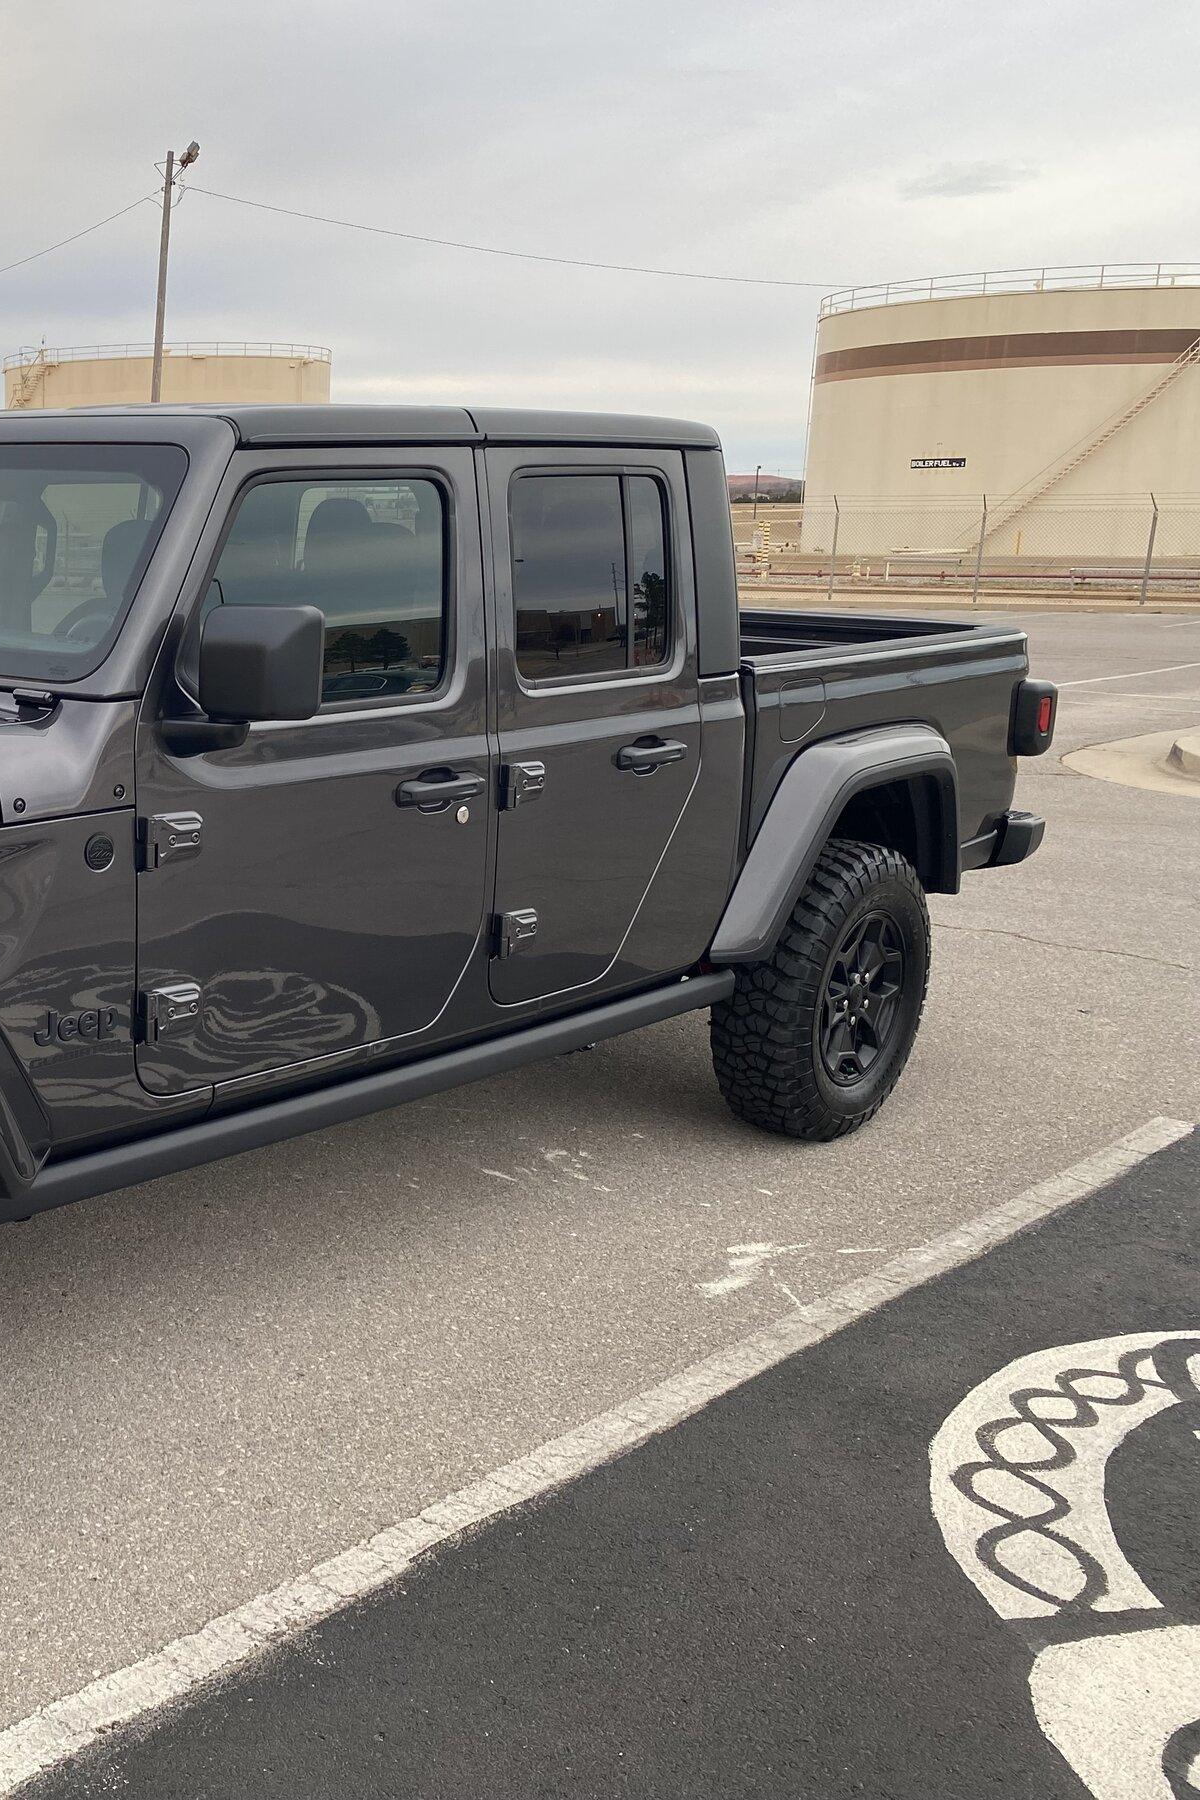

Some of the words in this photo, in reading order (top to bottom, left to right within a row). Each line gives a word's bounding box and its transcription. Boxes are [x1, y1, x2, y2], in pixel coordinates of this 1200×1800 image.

[911, 460, 934, 468] BOILER
[934, 459, 951, 467] FUEL
[33, 1005, 119, 1047] Jeep
